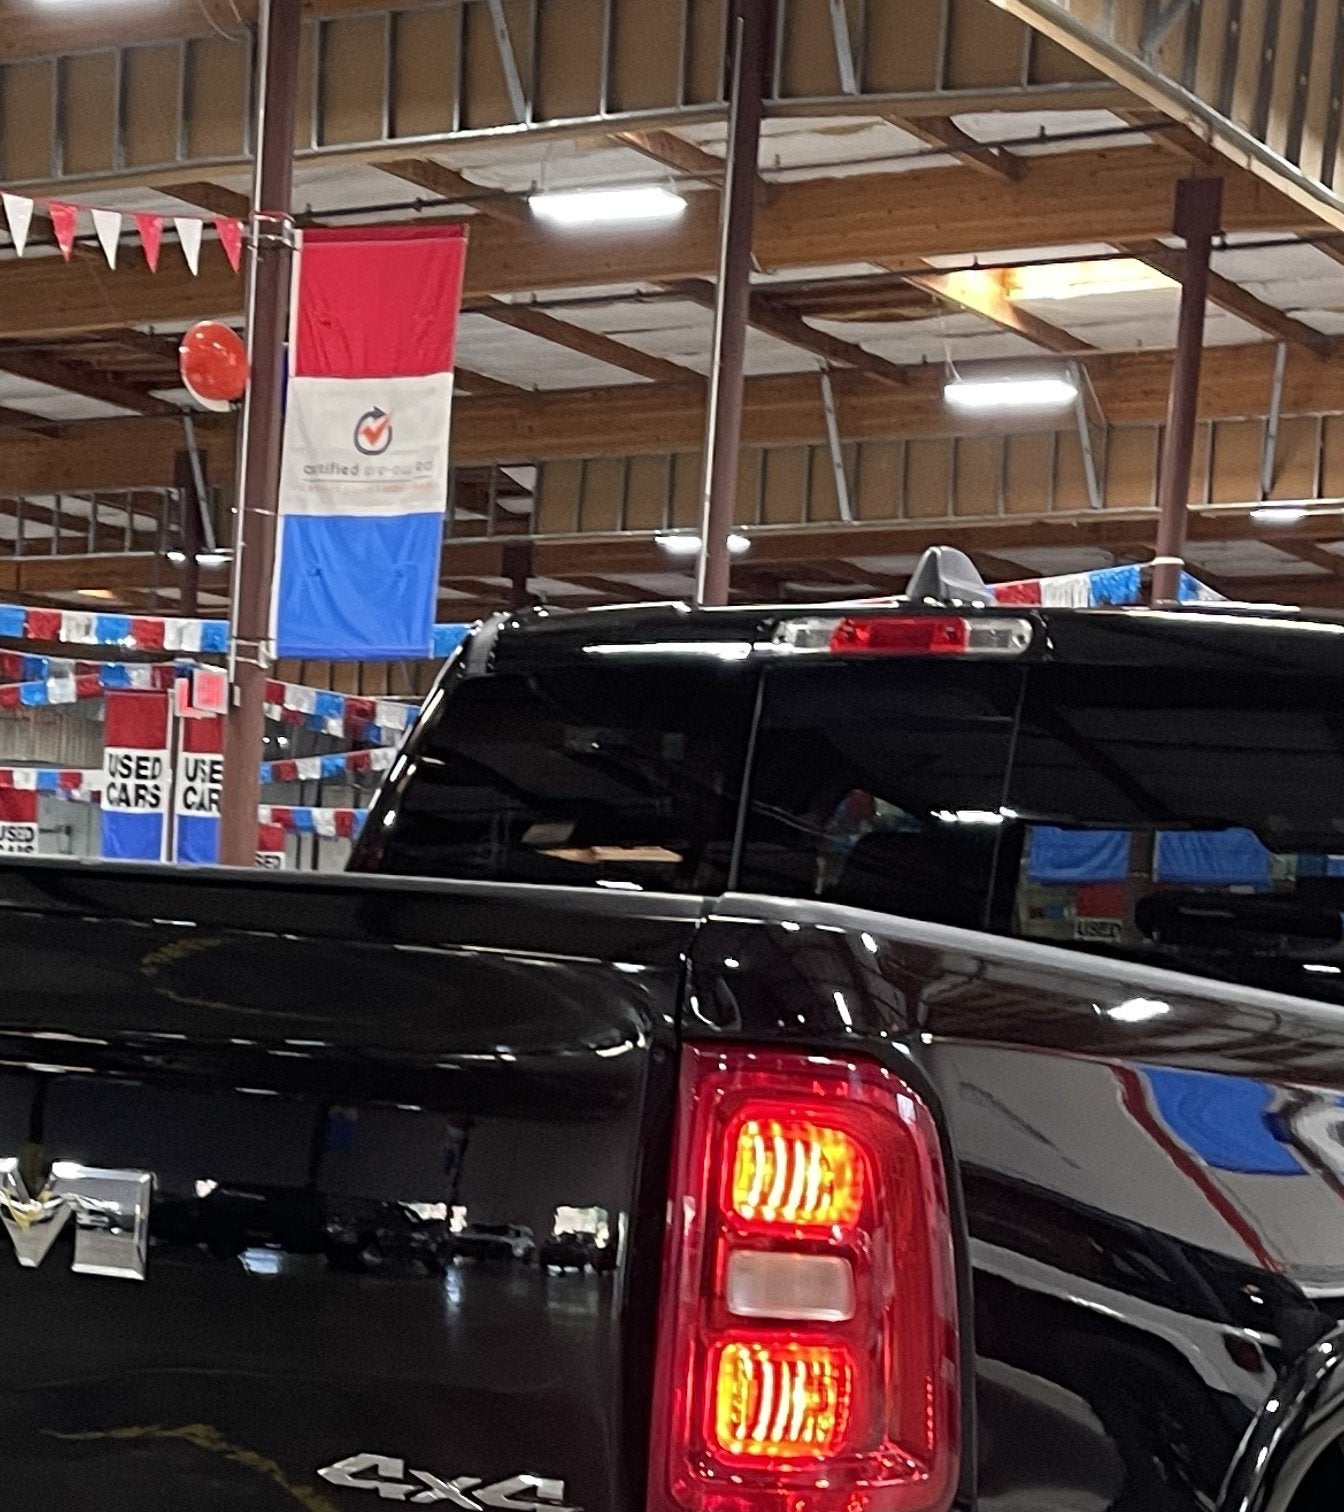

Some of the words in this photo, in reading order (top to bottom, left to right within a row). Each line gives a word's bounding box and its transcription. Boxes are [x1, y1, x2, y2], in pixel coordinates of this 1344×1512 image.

[108, 753, 162, 780] USED
[185, 757, 223, 783] USE
[106, 781, 161, 808] CARS
[183, 785, 221, 812] CAR
